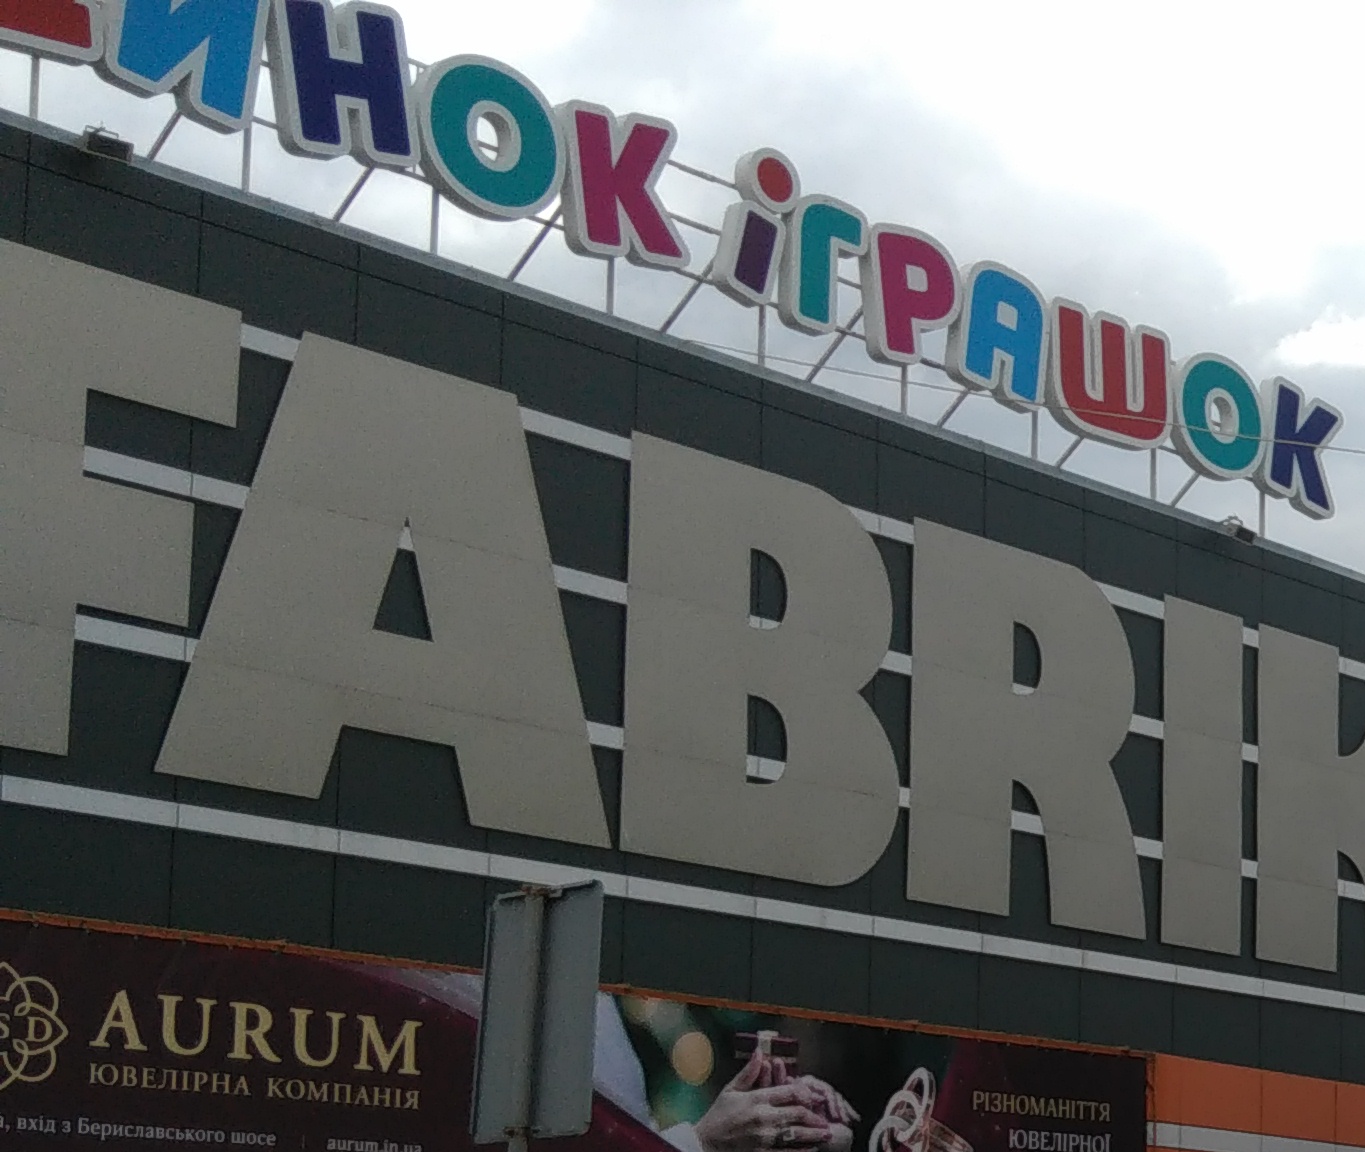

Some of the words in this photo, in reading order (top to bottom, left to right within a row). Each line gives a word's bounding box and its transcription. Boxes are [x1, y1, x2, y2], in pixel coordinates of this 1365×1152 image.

[89, 989, 424, 1076] AURUM
[89, 1062, 253, 1097] ЮВЕЛІРНА
[267, 1076, 421, 1110] КОМПАНІЯ
[972, 1089, 1111, 1123] РІЗНОМАНІТТЯ
[17, 1113, 57, 1135] вхід
[61, 1119, 72, 1134] з
[77, 1117, 226, 1144] Бериславського
[230, 1131, 277, 1147] шосе
